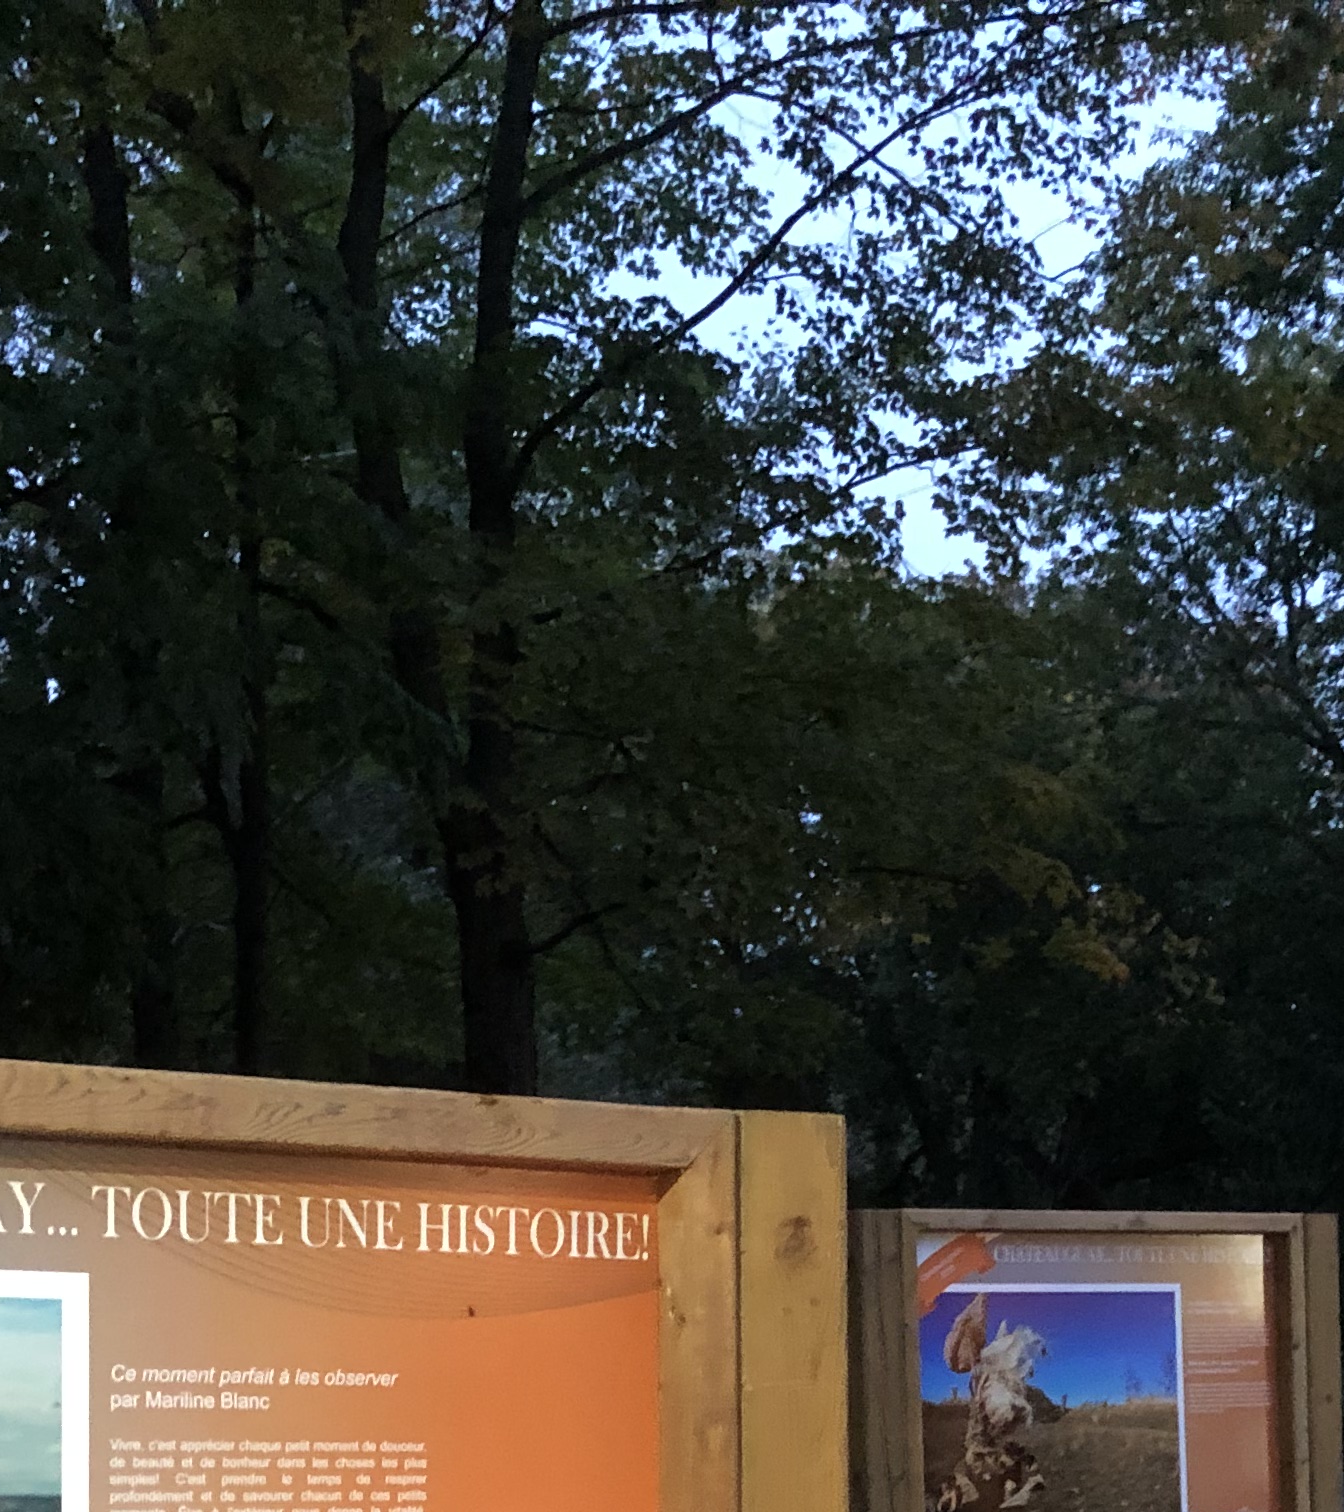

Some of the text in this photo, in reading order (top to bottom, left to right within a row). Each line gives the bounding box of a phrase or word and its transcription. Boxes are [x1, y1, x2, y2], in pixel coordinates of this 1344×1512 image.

[91, 1184, 284, 1246] TOUTE
[298, 1196, 404, 1252] UNE
[415, 1201, 652, 1262] HISTOIRE!
[111, 1363, 399, 1389] Ce moment parfait à les observer
[110, 1390, 269, 1412] par Mariline Blanc
[362, 1440, 377, 1452] de
[109, 1456, 126, 1468] de
[181, 1457, 193, 1468] et
[199, 1457, 216, 1469] de
[200, 1491, 213, 1502] et
[219, 1490, 236, 1502] de
[348, 1489, 363, 1502] de
